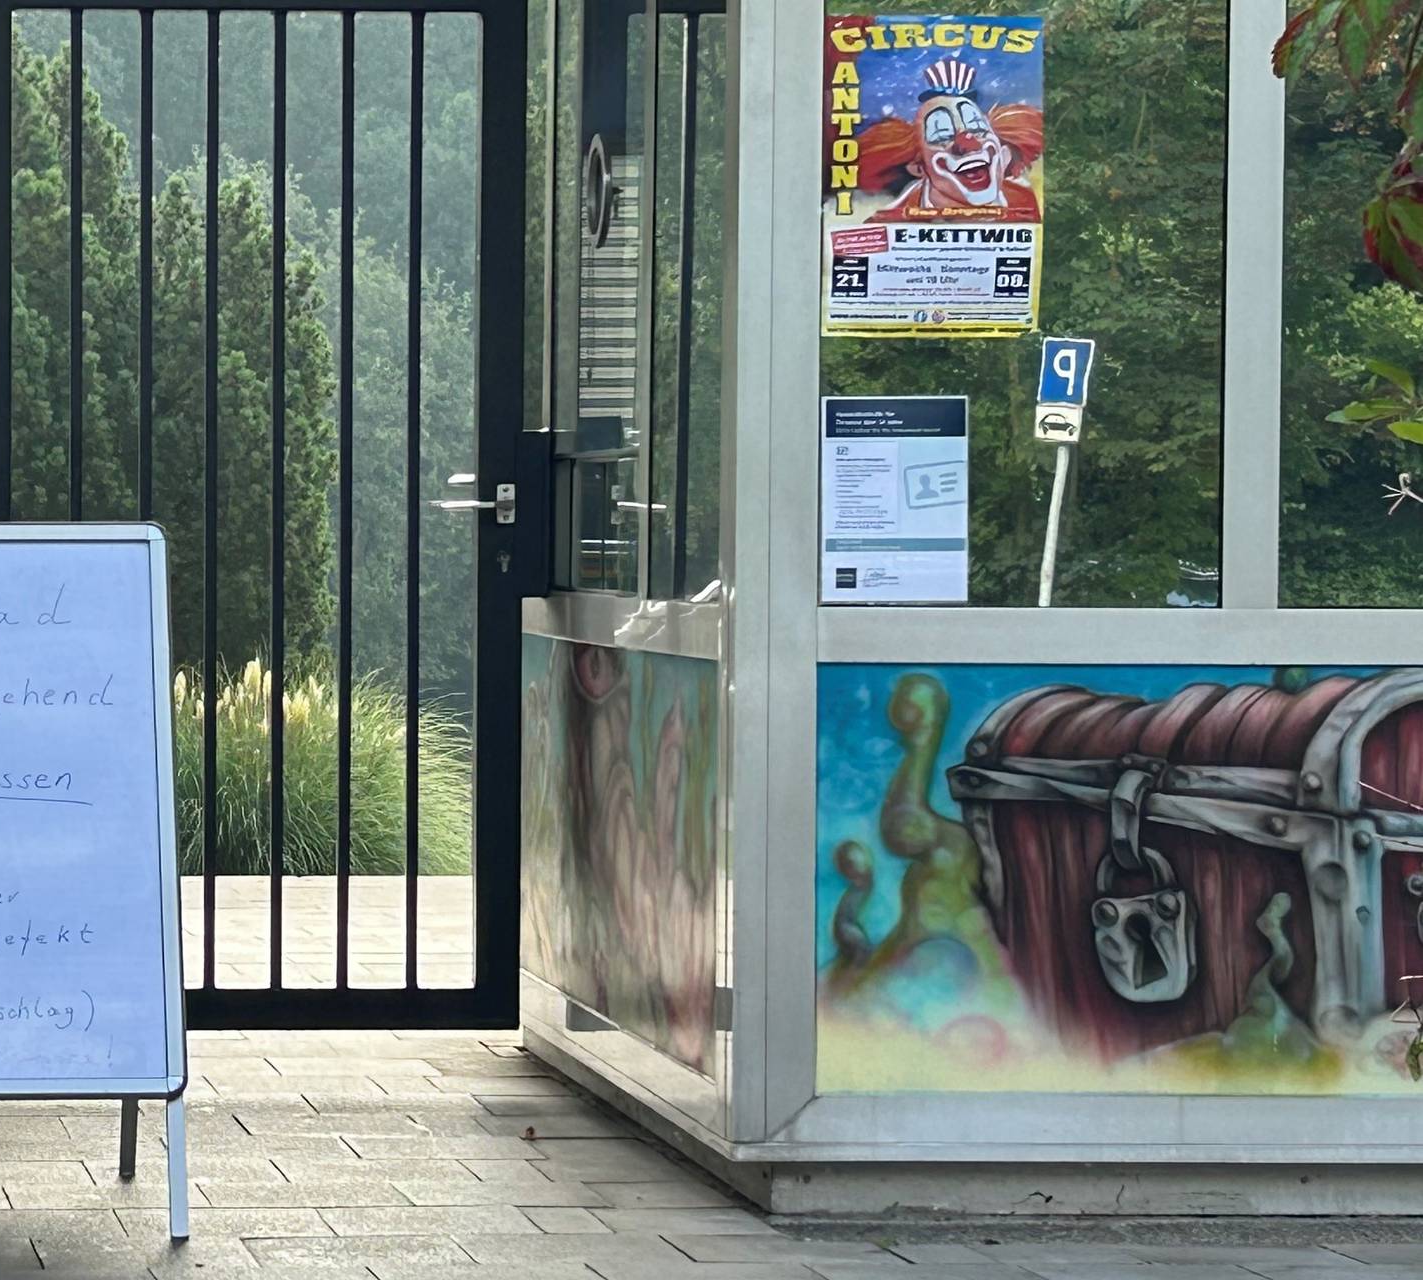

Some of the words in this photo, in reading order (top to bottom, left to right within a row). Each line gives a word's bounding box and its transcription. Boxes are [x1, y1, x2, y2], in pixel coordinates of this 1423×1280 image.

[830, 23, 1040, 53] CIRCUS
[831, 61, 862, 216] ANTONI
[894, 228, 1033, 243] E-KETTWIG
[835, 273, 864, 287] 21.
